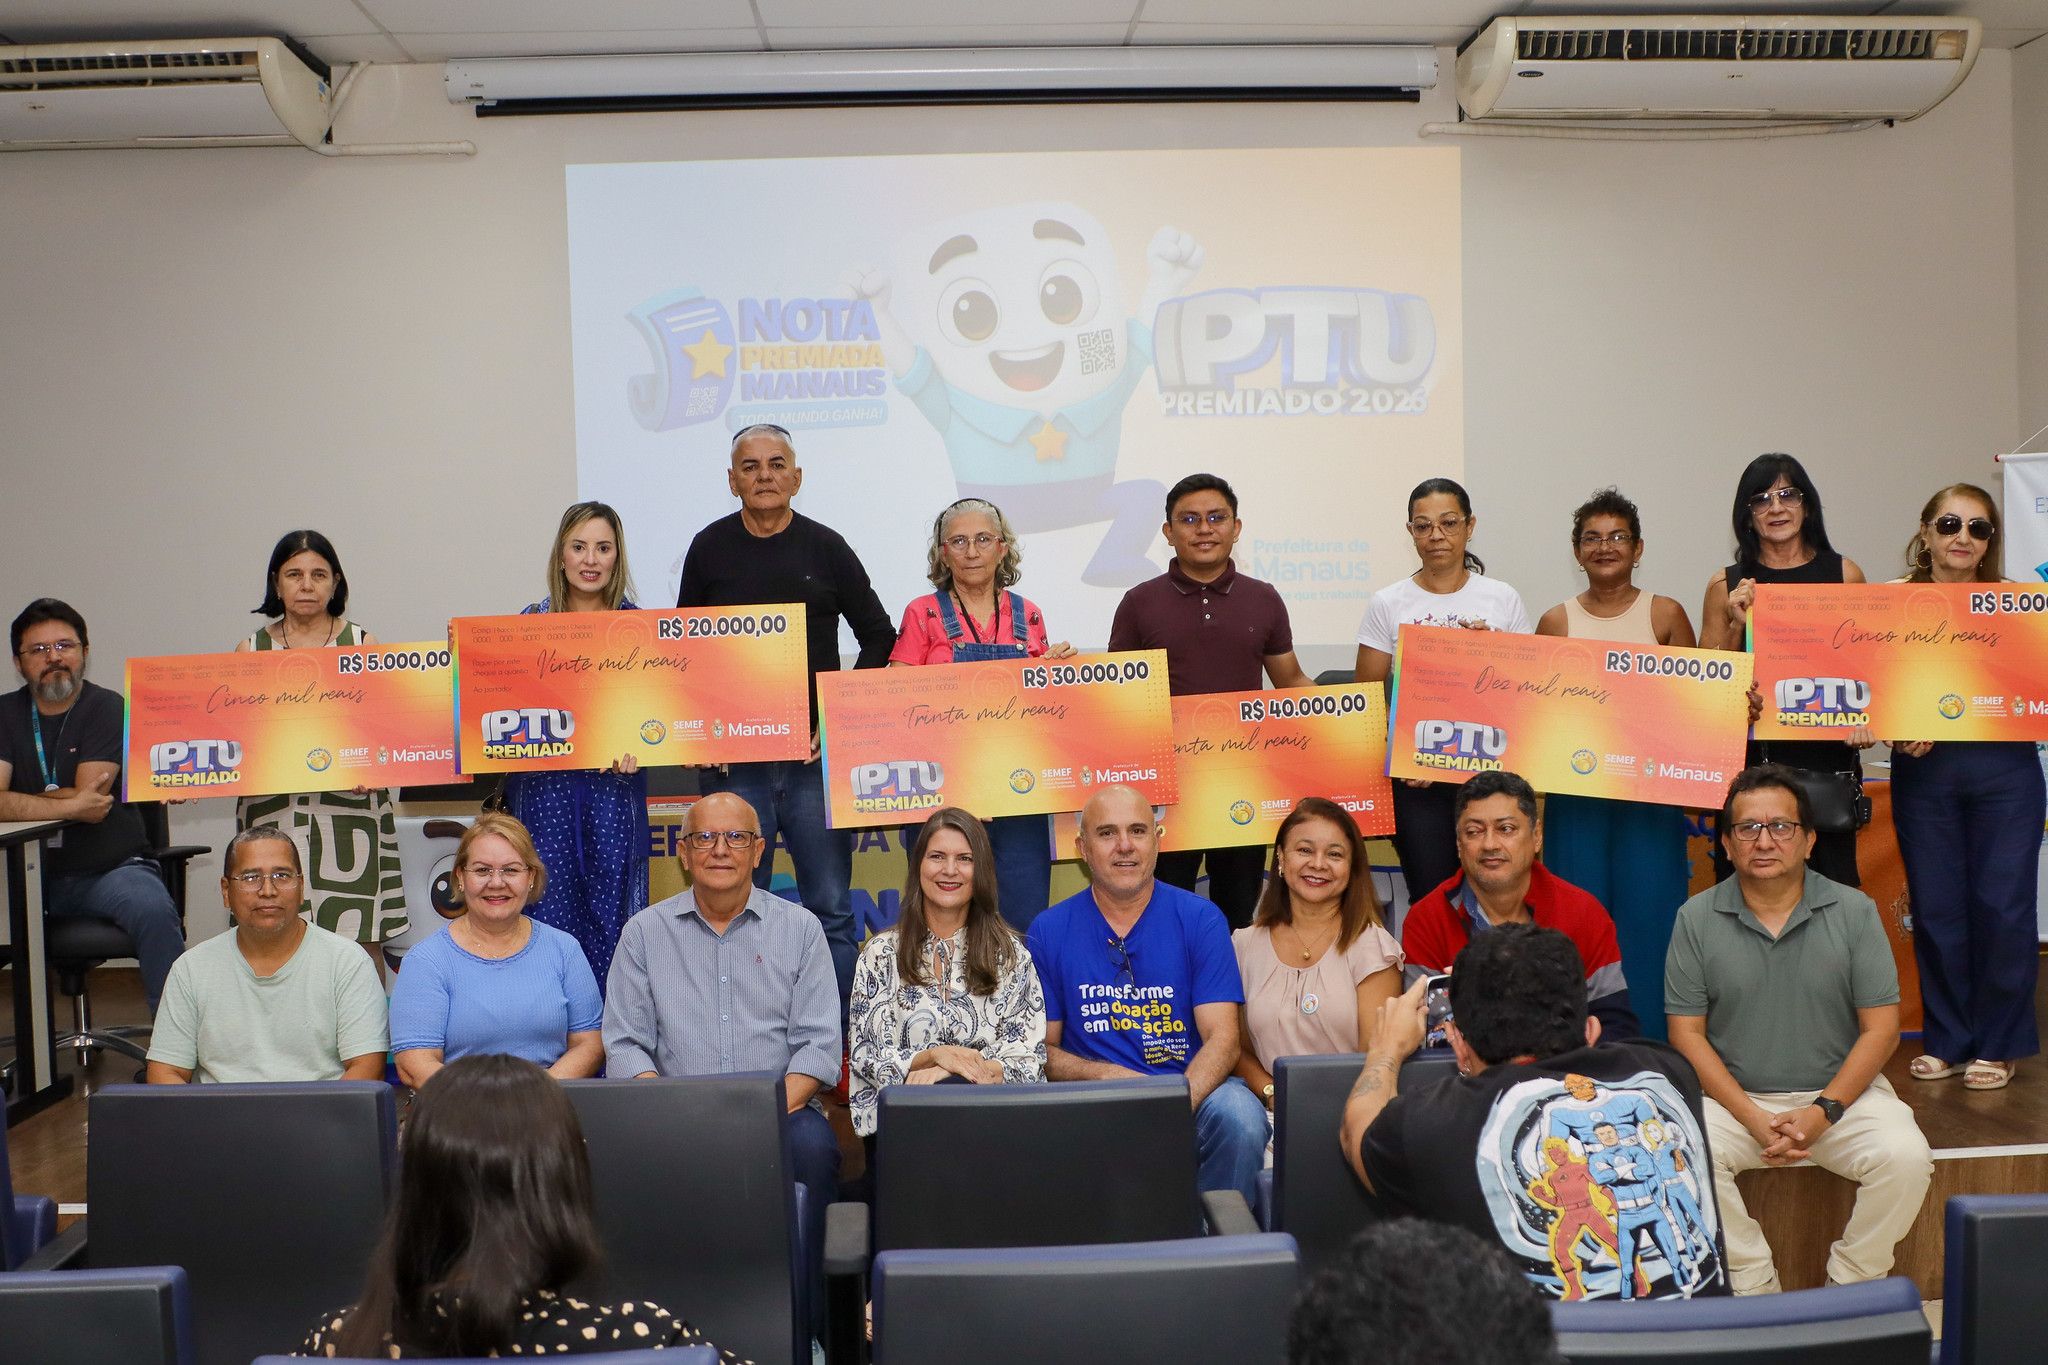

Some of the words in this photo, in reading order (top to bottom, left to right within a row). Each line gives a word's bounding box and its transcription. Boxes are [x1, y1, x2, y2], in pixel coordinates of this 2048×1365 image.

[738, 297, 881, 342] NOTA
[1153, 287, 1435, 386] IPTU
[740, 345, 885, 370] PREMIADA
[741, 370, 886, 401] MANAUS
[1161, 389, 1343, 415] PREMIADO
[1350, 388, 1428, 414] 2026
[738, 413, 776, 428] TODO
[779, 410, 828, 425] MUNDO
[832, 407, 884, 421] GANHA!
[1253, 539, 1344, 554] Prefeitura
[1348, 538, 1370, 553] de
[1253, 557, 1370, 581] Manaus
[1294, 592, 1317, 603] que
[1320, 590, 1371, 600] trabalha
[1971, 592, 1996, 614] R$
[2002, 593, 2048, 614] 5.00
[659, 618, 683, 640] R$
[689, 614, 787, 638] 20.000,00
[1832, 619, 1898, 649] Cinco
[1904, 619, 1948, 645] mil
[1950, 628, 2002, 647] reais
[339, 655, 363, 674] R$
[368, 650, 452, 672] 5.000,00
[537, 648, 593, 680] Vinte
[598, 646, 640, 672] mil
[641, 655, 692, 673] reais
[1606, 651, 1631, 674] R$
[1636, 654, 1733, 682] 10.000,00
[1024, 667, 1048, 689] R$
[1052, 661, 1149, 685] 30.000,00
[1474, 665, 1511, 694] Dez
[1517, 673, 1561, 697] mil
[1561, 685, 1612, 705] reais
[206, 684, 270, 714] Cinco
[276, 681, 317, 705] mil
[319, 687, 368, 705] reais
[1775, 677, 1871, 709] IPTU
[1972, 696, 2004, 705] SEMEF
[902, 704, 970, 729] Trinta
[977, 696, 1016, 721] mil
[1021, 703, 1069, 722] reais
[1241, 700, 1265, 722] R$
[1269, 694, 1366, 718] 40.000,00
[1775, 711, 1870, 727] PREMIADO
[481, 707, 575, 743] IPTU
[672, 719, 704, 730] SEMEF
[728, 723, 791, 737] Manaus
[1221, 727, 1260, 752] mil
[1264, 732, 1312, 750] reais
[1414, 719, 1508, 756] IPTU
[150, 739, 243, 772] IPTU
[339, 747, 369, 757] SEMEF
[392, 749, 454, 763] Manaus
[482, 741, 575, 759] PREMIADO
[1604, 754, 1637, 765] SEMEF
[1041, 767, 1072, 778] SEMEF
[1413, 752, 1504, 772] PREMIADO
[1659, 763, 1723, 783] Manaus
[150, 770, 241, 788] PREMIADO
[850, 760, 944, 795] IPTU
[1096, 768, 1157, 784] Manaus
[853, 794, 944, 813] PREMIADO
[1261, 799, 1291, 810] SEMEF
[1338, 799, 1375, 813] naus
[1078, 983, 1174, 1000] Transforme
[1080, 1002, 1110, 1017] sua
[1111, 999, 1172, 1021] doação
[1083, 1019, 1110, 1033] em
[1142, 1016, 1187, 1037] ação.
